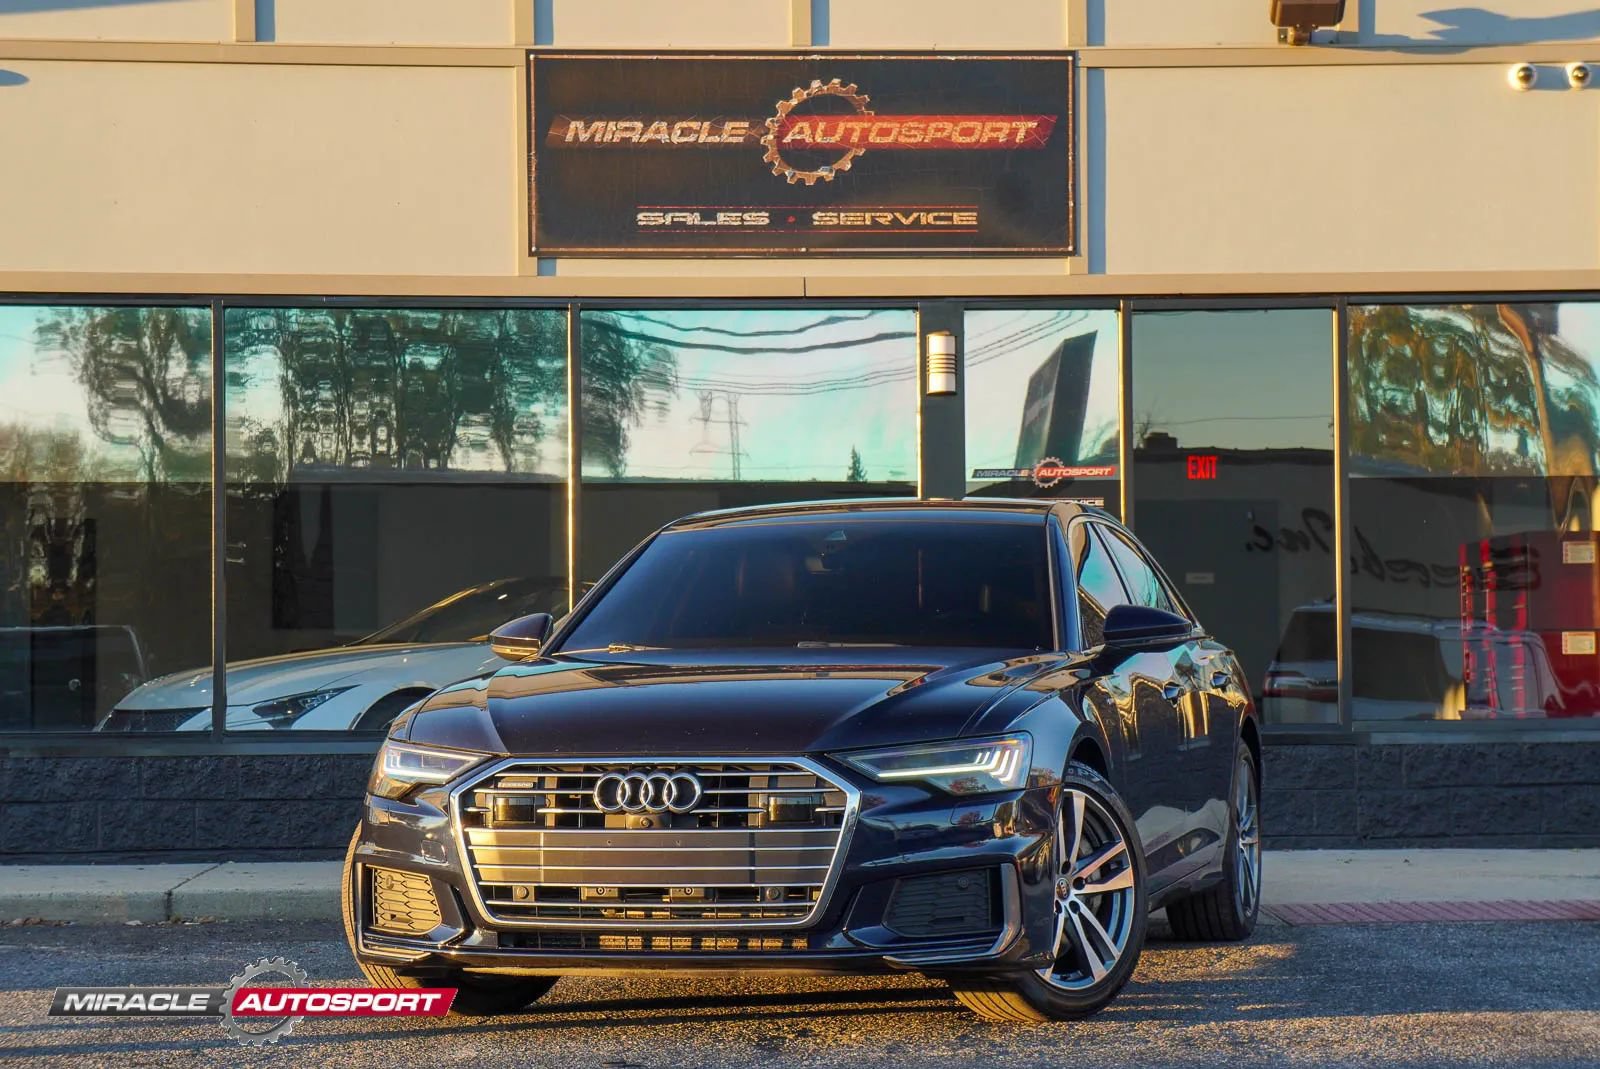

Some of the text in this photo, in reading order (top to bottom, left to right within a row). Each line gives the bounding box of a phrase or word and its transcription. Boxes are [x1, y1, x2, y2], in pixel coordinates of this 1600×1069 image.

[564, 120, 1038, 145] MIRACLE AUTOSPORT
[636, 211, 979, 226] SALES SERVICE
[976, 467, 1112, 477] MIRACLE AUTOSPORT
[1188, 456, 1217, 480] EXIT
